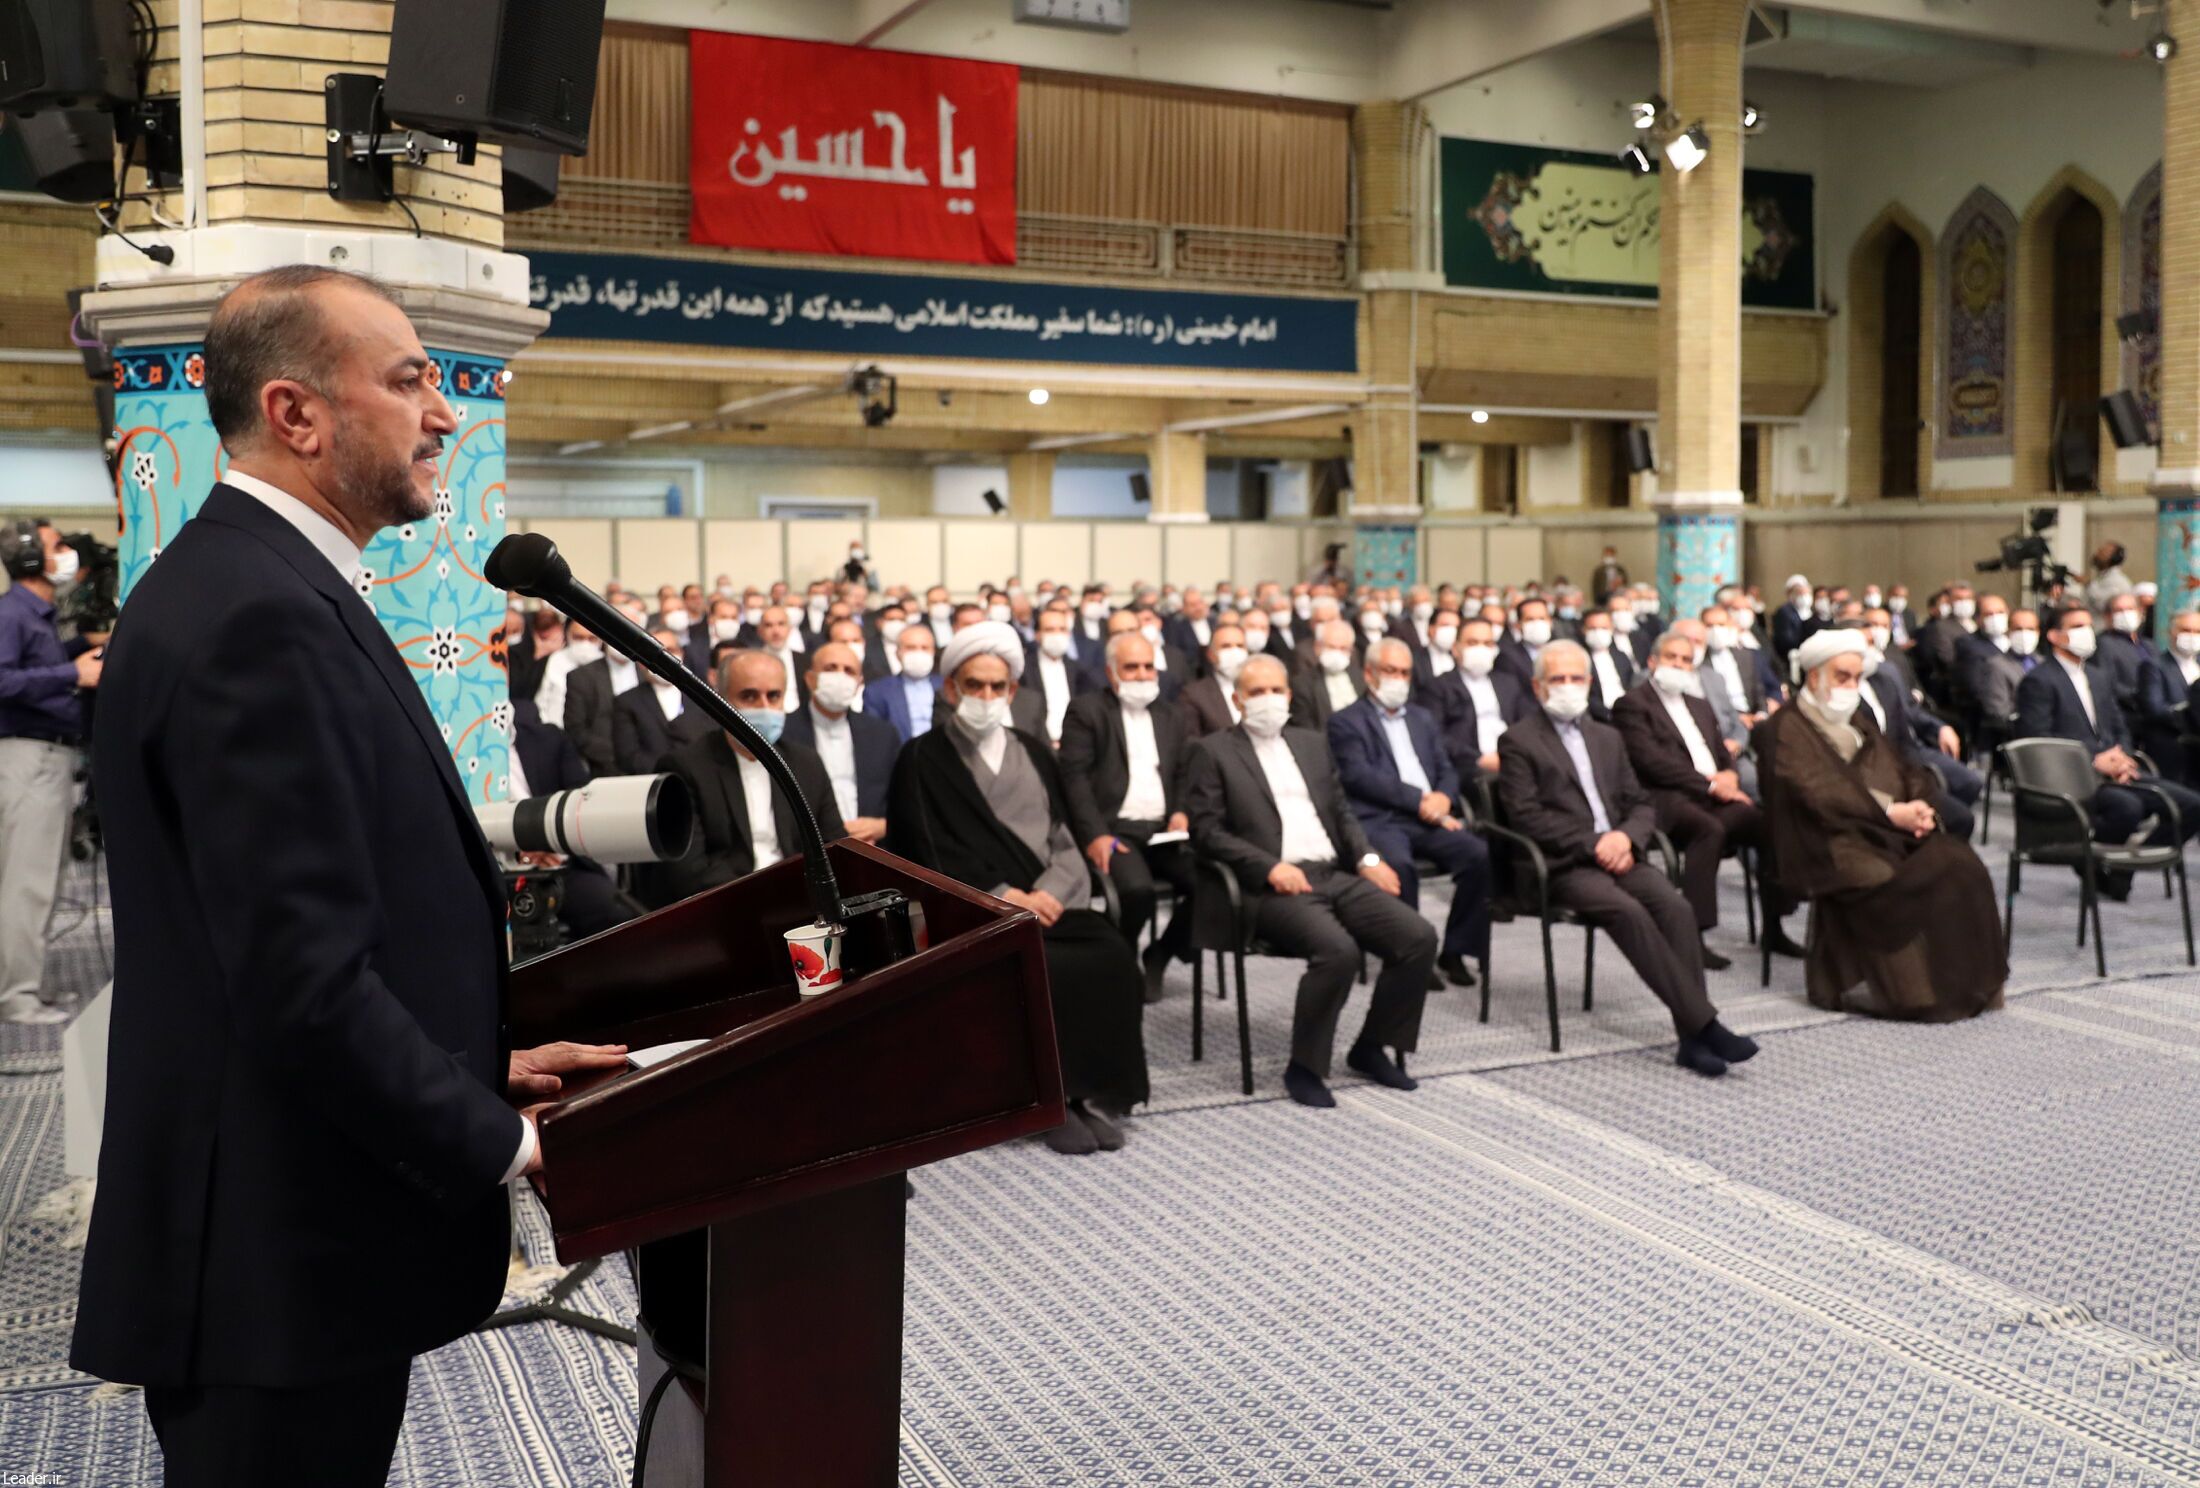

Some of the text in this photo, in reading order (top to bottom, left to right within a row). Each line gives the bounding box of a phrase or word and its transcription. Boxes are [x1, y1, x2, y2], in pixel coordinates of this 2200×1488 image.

[729, 93, 976, 214] یا حسین
[681, 285, 723, 320] این
[724, 292, 769, 317] همه
[769, 291, 793, 326] از
[894, 298, 969, 332] اسلامی
[968, 303, 1039, 332] مملکت
[1038, 306, 1086, 340] سفیر
[1086, 308, 1124, 335] شما
[1175, 314, 1238, 345] خمینی
[1239, 314, 1278, 347] امام
